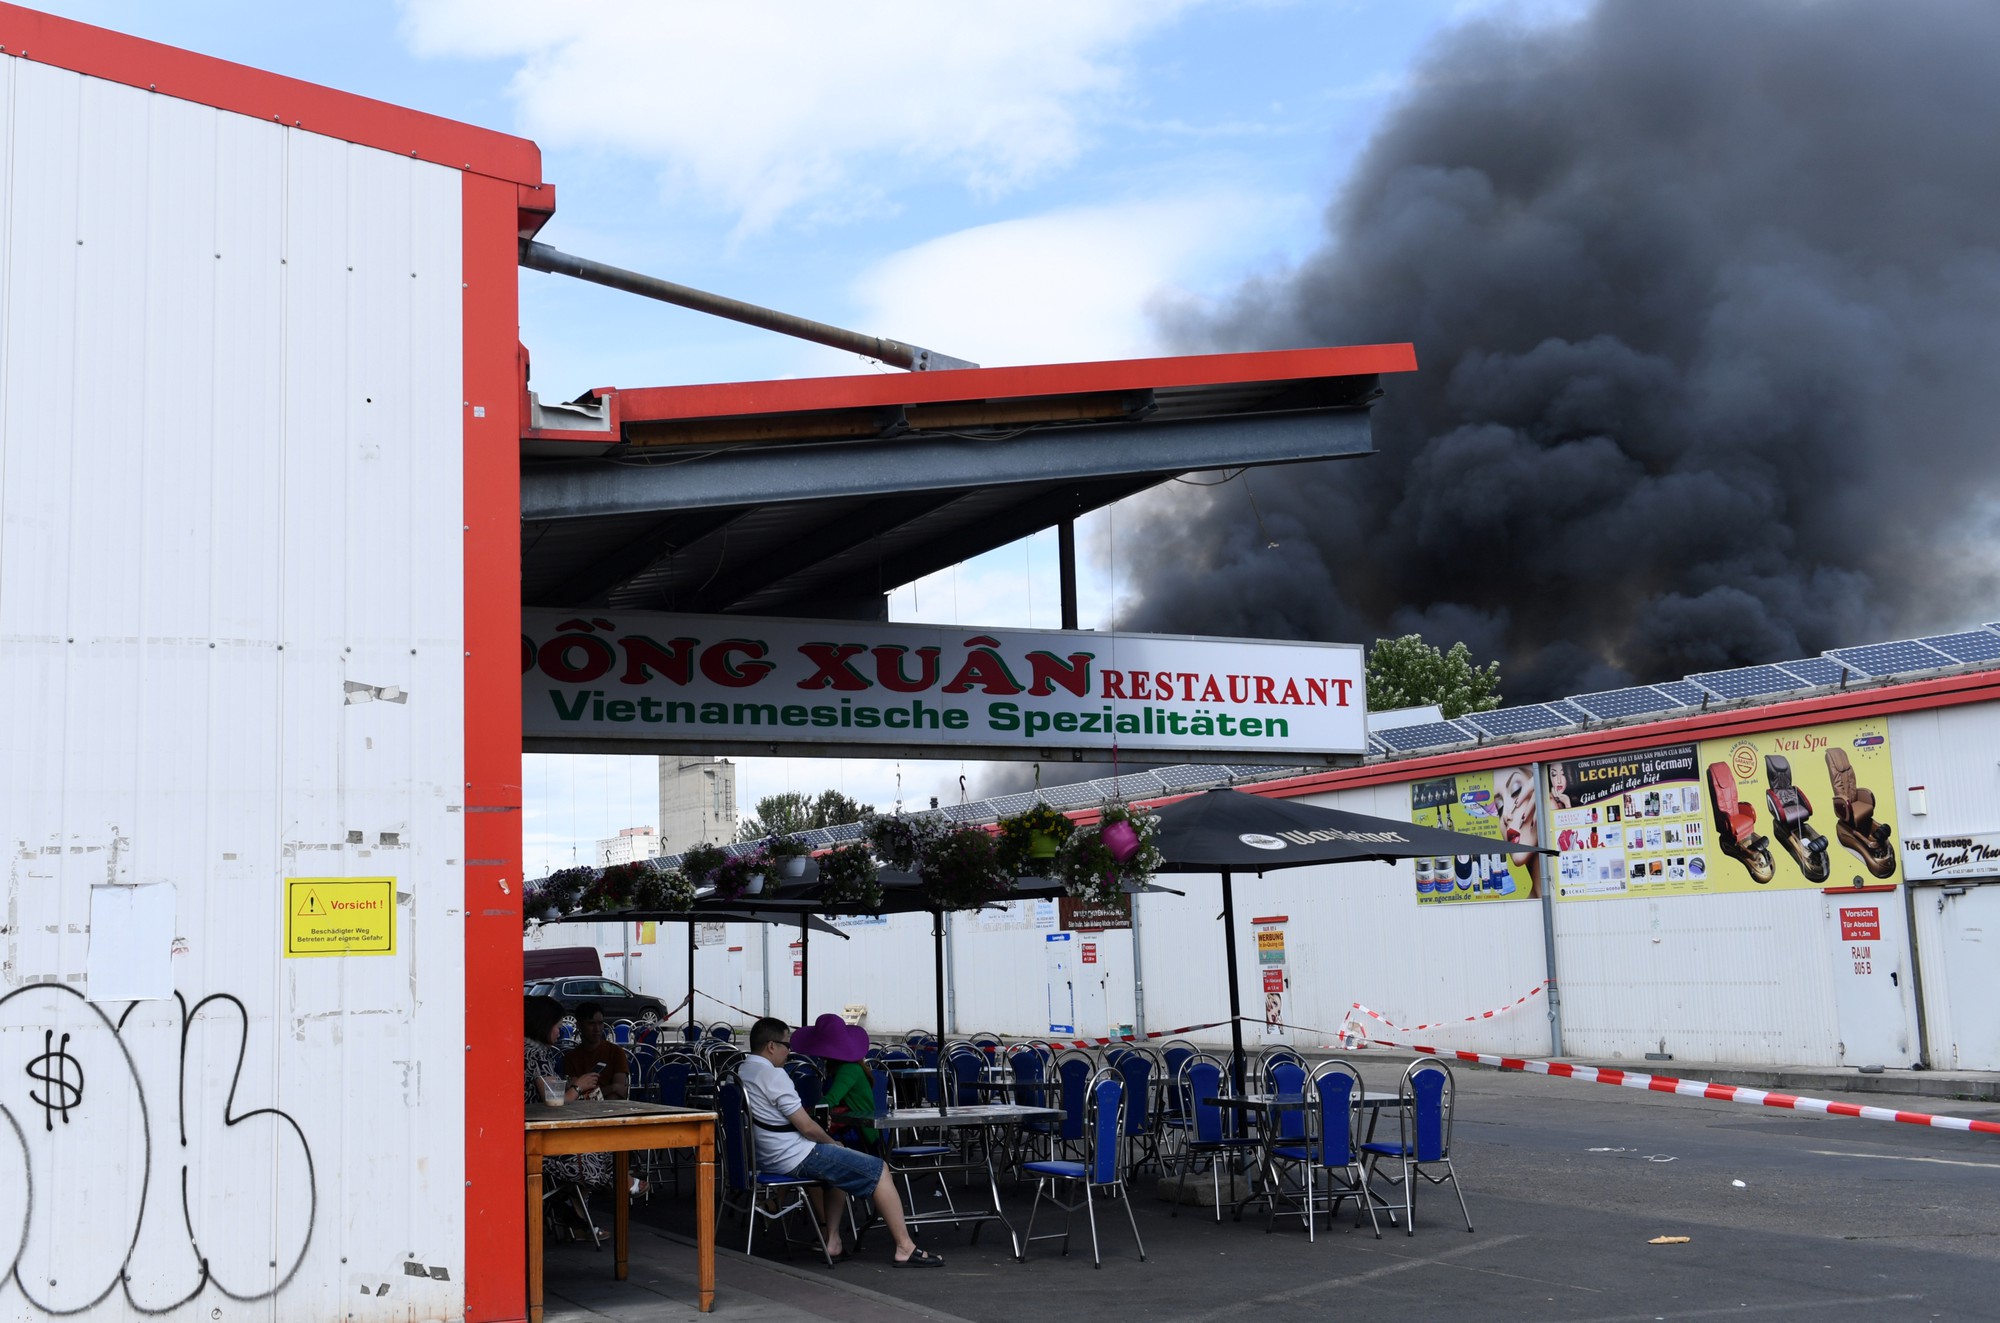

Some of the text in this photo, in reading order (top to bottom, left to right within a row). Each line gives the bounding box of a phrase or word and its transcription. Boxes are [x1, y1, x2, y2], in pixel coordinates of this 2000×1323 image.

[796, 635, 1095, 698] XUÂN
[1100, 669, 1352, 706] RESTAURANT
[549, 689, 1289, 738] Vietnamesische Spezialitäten
[1774, 734, 1828, 752] Neu Spa
[1580, 757, 1693, 782] LECHAT tại Germany
[1904, 840, 1921, 851] Tóc
[1932, 838, 1973, 849] Massage
[1925, 849, 1969, 869] Thanh
[331, 900, 376, 909] Vorsicht
[1845, 909, 1874, 918] Vorsicht
[311, 927, 370, 936] Beschädigter Weg
[1258, 932, 1284, 942] WERBUNG
[338, 935, 360, 943] eigene
[1851, 946, 1872, 960] RAUM
[1853, 961, 1872, 975] 805 B
